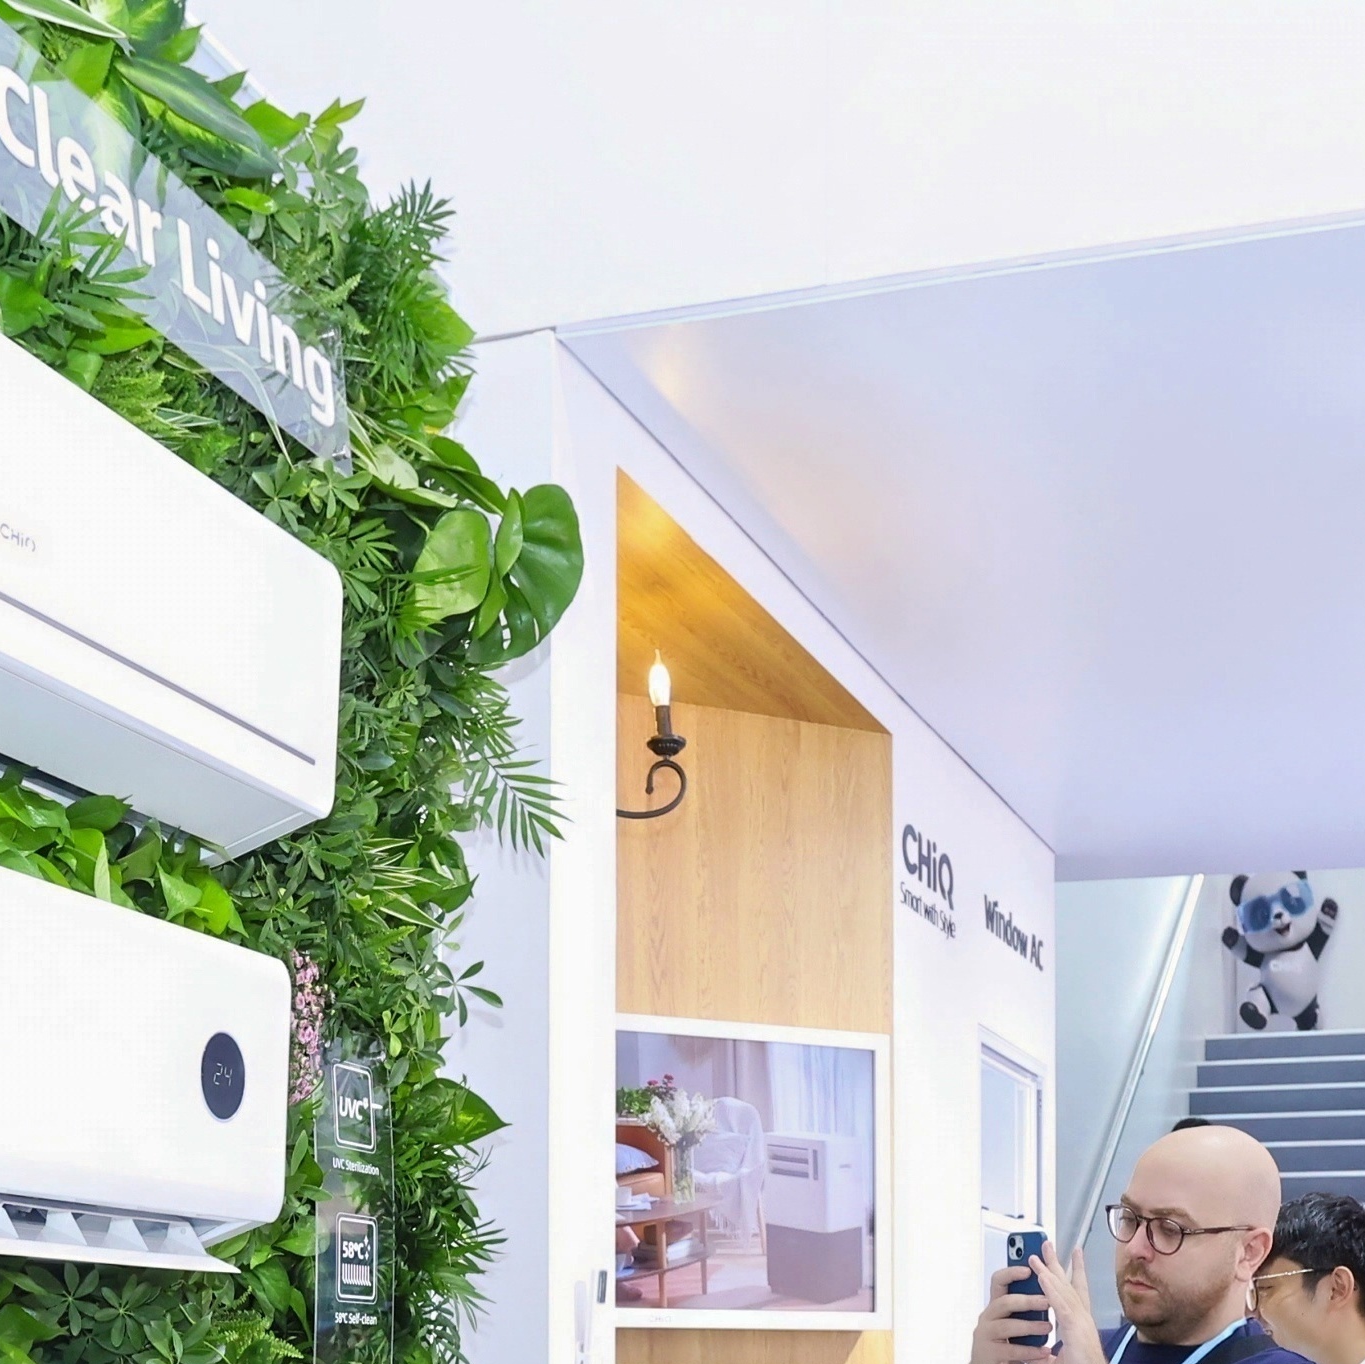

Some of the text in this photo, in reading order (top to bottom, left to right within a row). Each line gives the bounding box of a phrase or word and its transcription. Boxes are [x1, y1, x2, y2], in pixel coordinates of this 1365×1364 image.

[177, 217, 335, 427] Living
[902, 824, 954, 911] CHiQ
[900, 881, 956, 939] Smart with Style
[984, 894, 1044, 972] Window AC
[213, 1062, 233, 1087] 24
[339, 1096, 363, 1120] UVC
[332, 1157, 379, 1176] UVC Sterilization
[349, 1312, 377, 1325] Self-clean
